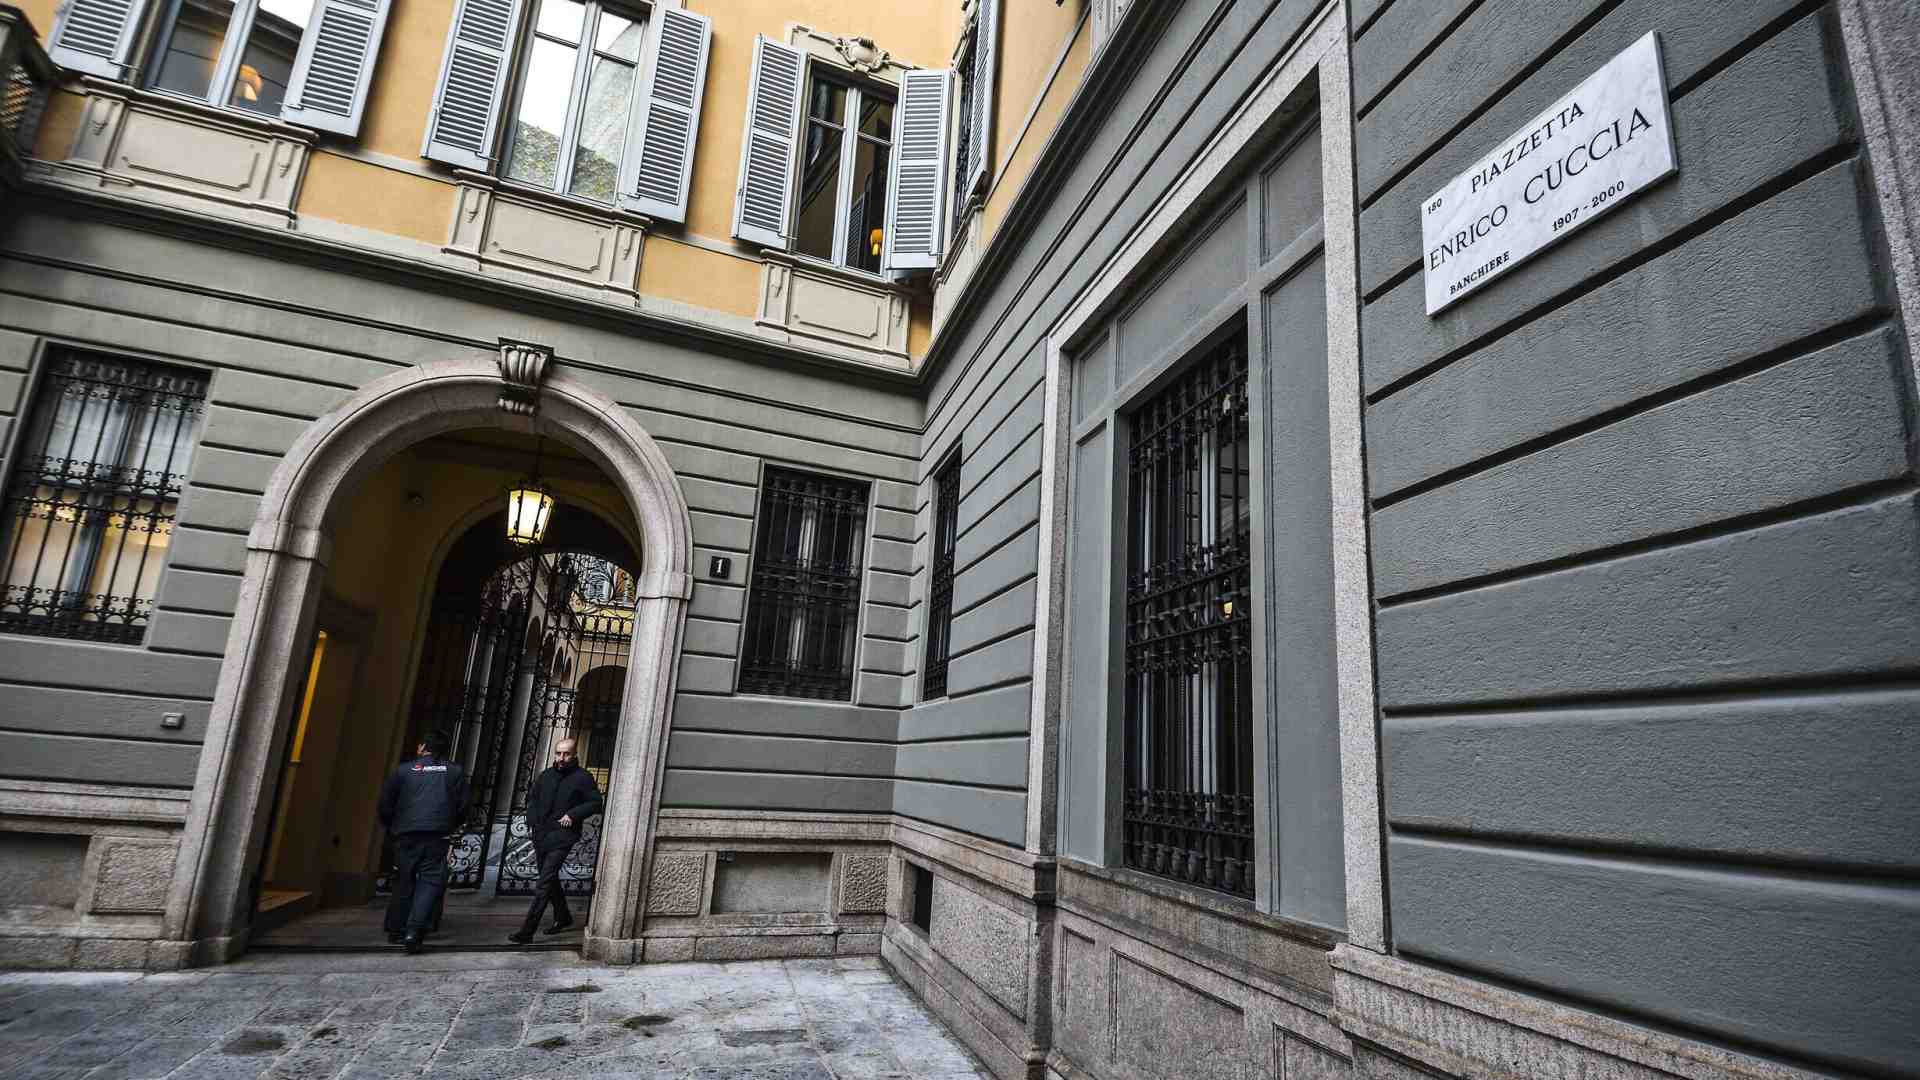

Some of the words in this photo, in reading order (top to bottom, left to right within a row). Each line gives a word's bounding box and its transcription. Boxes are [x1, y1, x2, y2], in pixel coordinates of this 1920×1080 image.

[1471, 102, 1585, 194] PIAZZETTA
[1429, 204, 1508, 271] ENRICO
[1523, 107, 1653, 204] CUCCIA
[1449, 250, 1511, 295] BANCHIERE
[716, 558, 723, 574] 1
